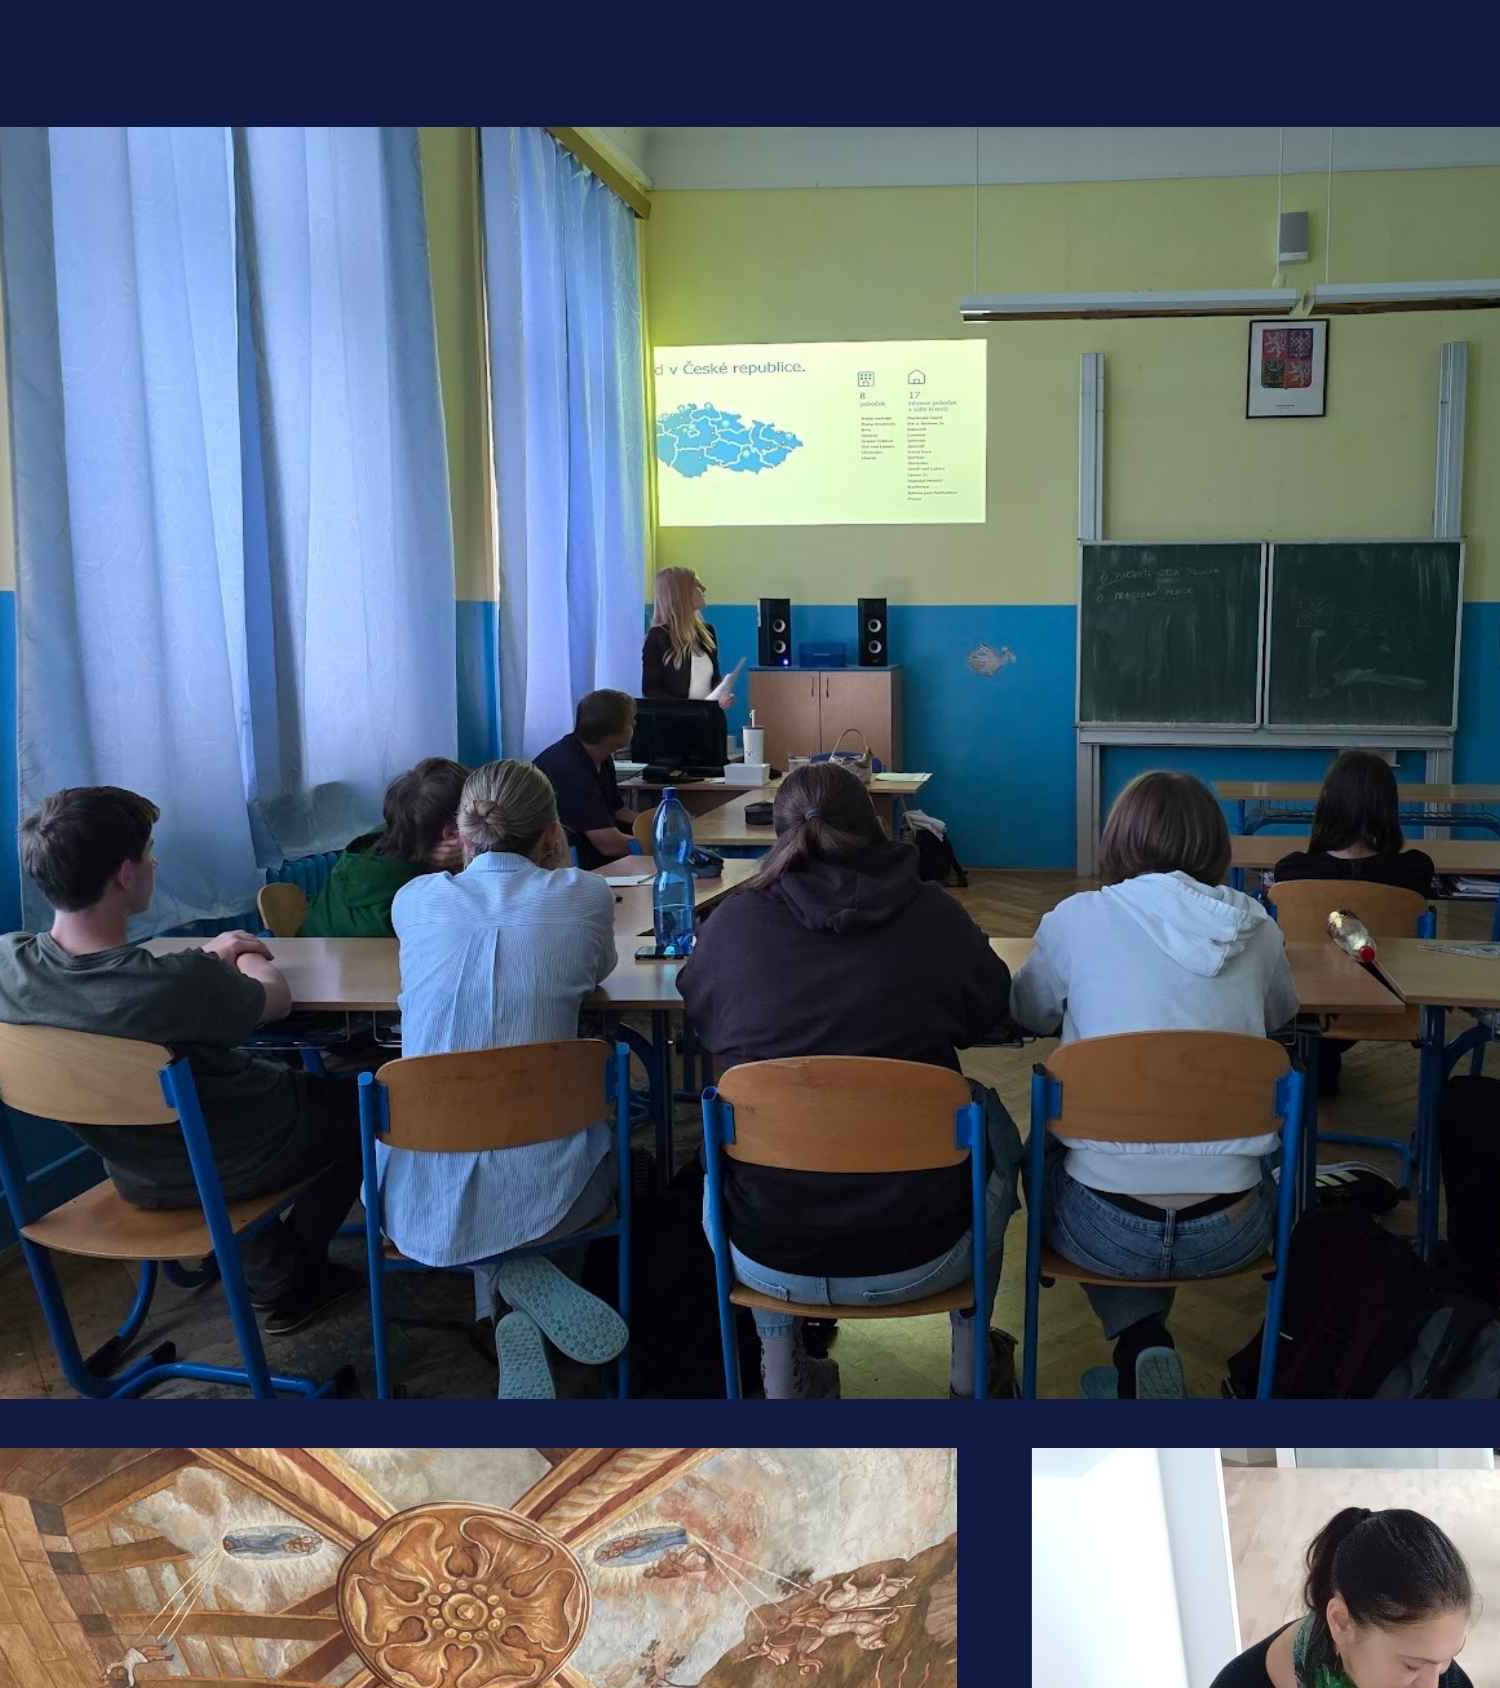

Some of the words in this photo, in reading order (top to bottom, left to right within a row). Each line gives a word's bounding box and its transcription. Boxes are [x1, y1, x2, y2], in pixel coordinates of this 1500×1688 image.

[669, 366, 678, 375] v
[682, 360, 728, 375] České
[733, 360, 806, 376] republice.
